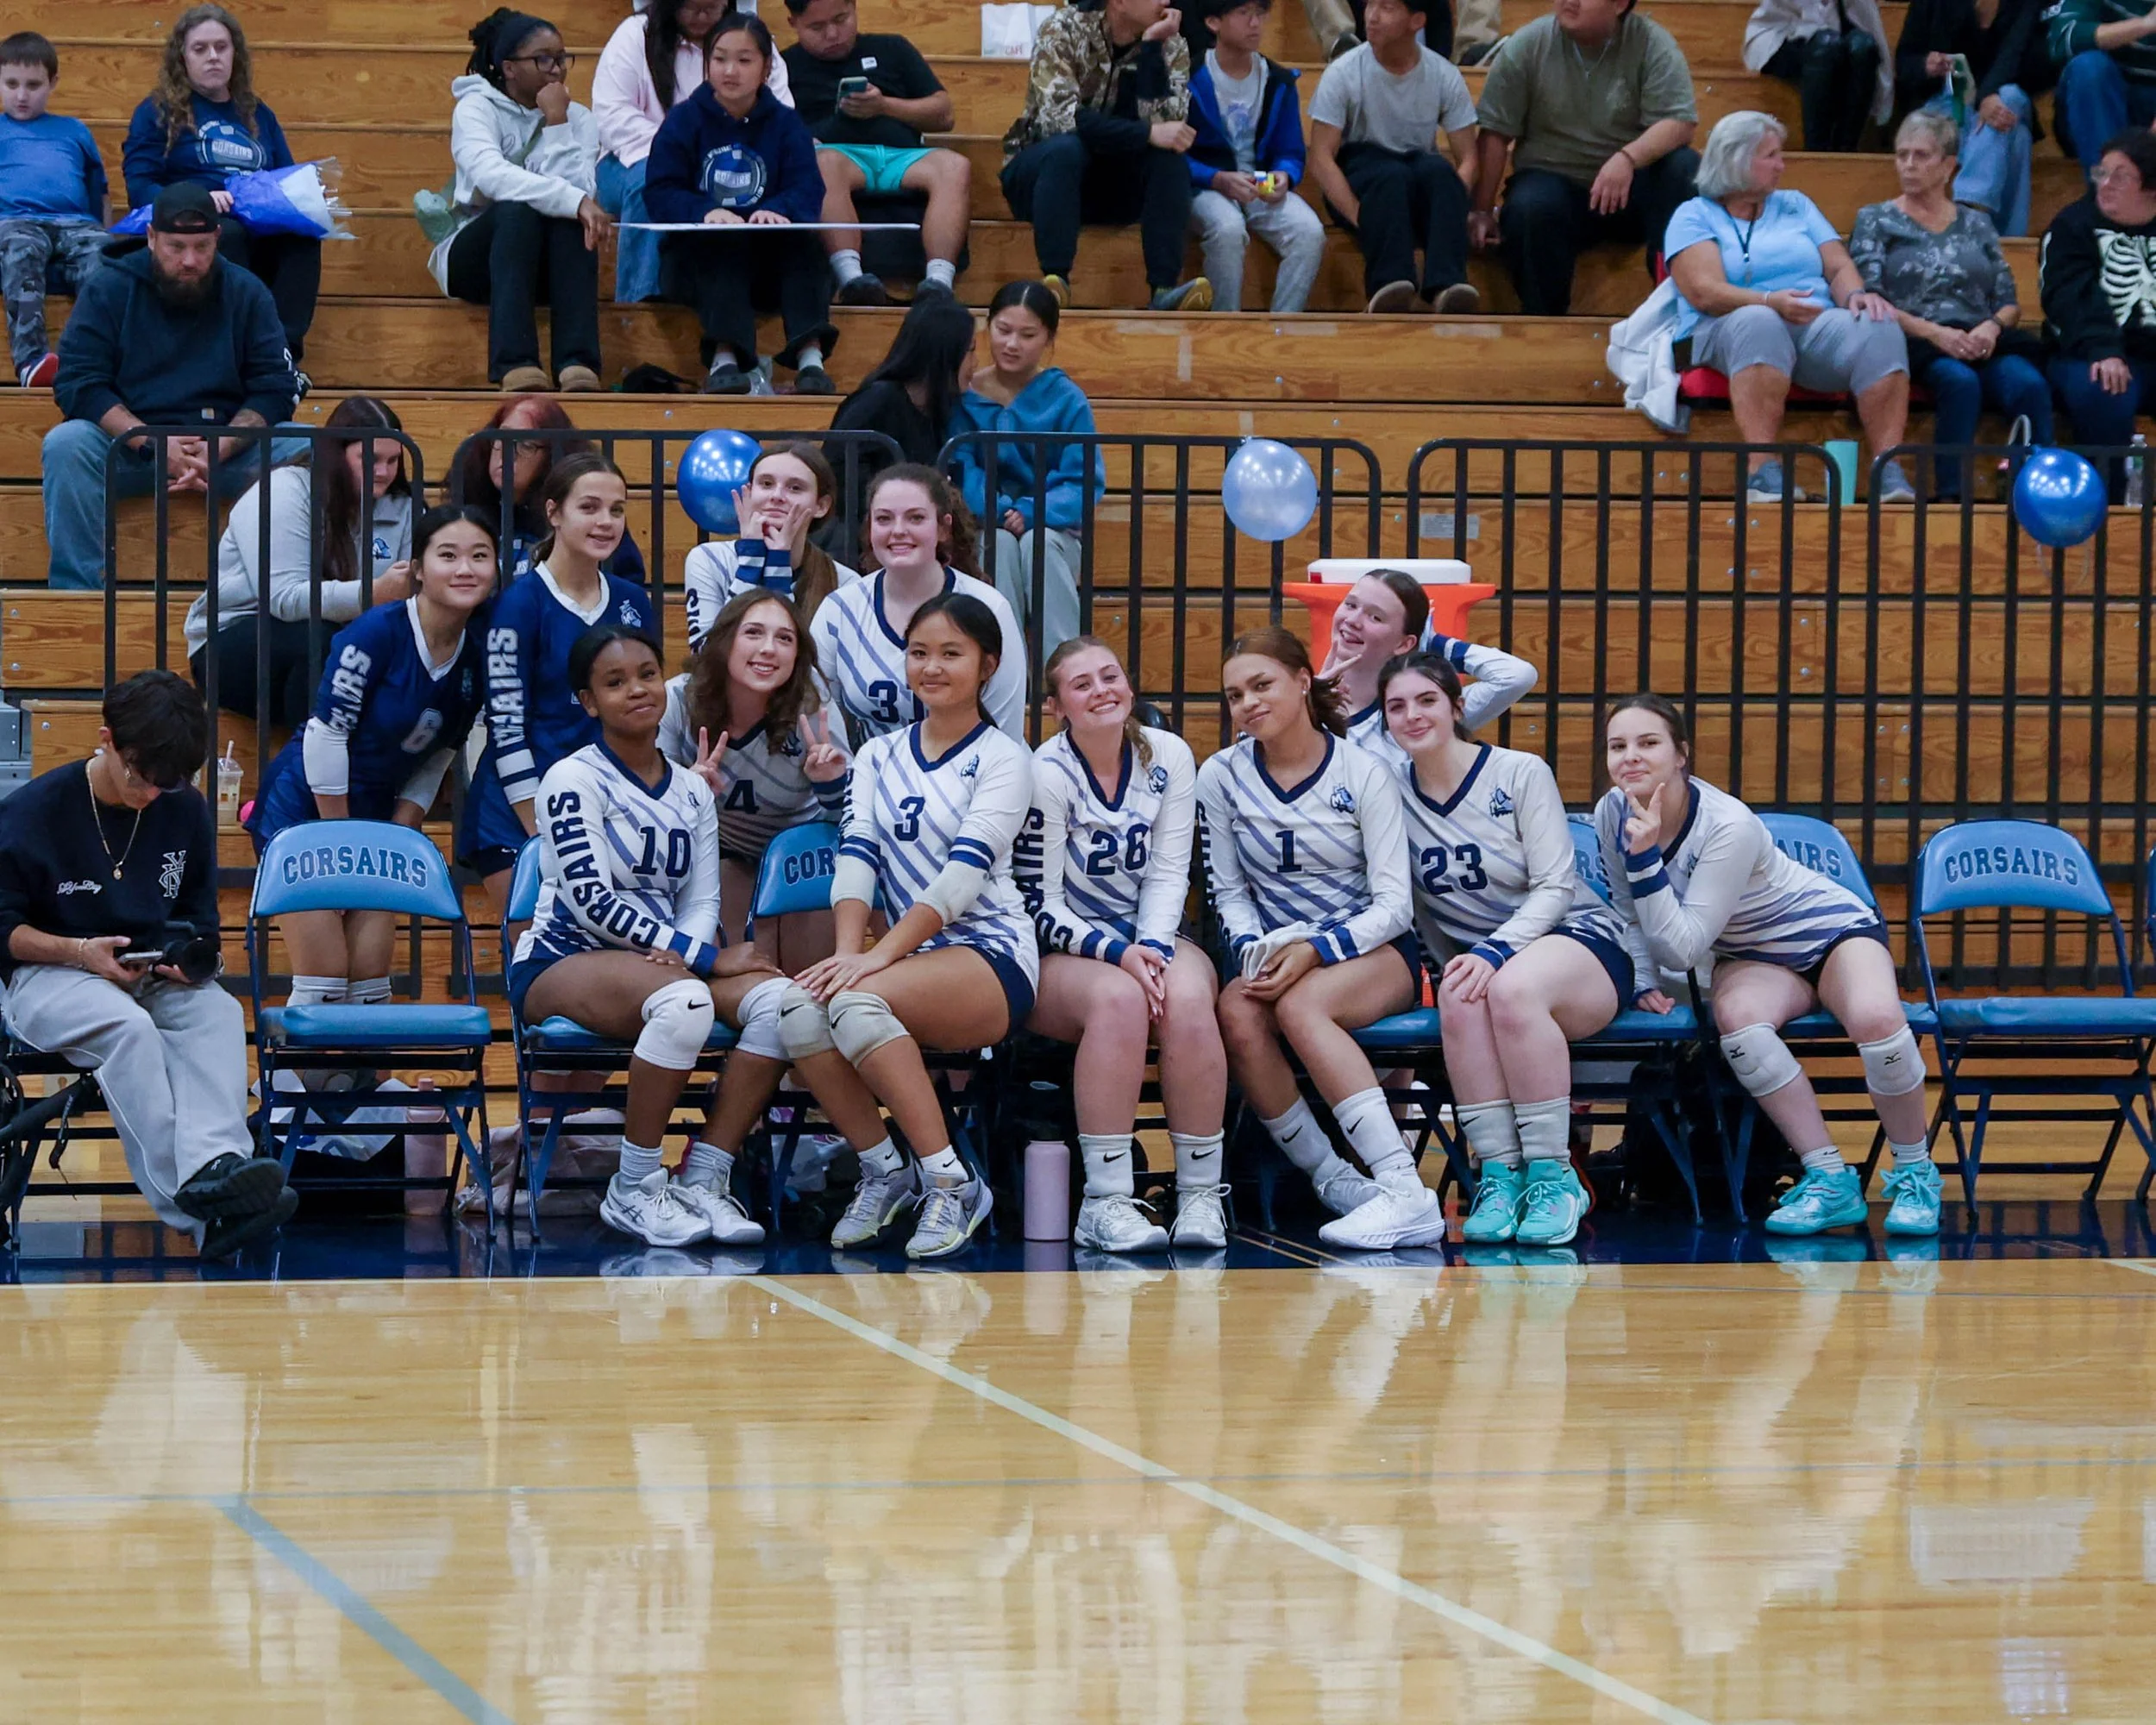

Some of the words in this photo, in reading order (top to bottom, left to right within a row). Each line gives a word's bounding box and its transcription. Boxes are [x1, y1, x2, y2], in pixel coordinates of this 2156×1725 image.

[724, 779, 760, 815] 4
[893, 796, 926, 842] 3
[283, 845, 429, 889] CORSAIRS
[547, 790, 661, 948] CORSAIRS
[632, 825, 691, 878] 10
[1086, 823, 1150, 875] 26
[1275, 829, 1302, 873] 1
[1420, 843, 1489, 895] 23
[1944, 845, 2078, 887] CORSAIRS
